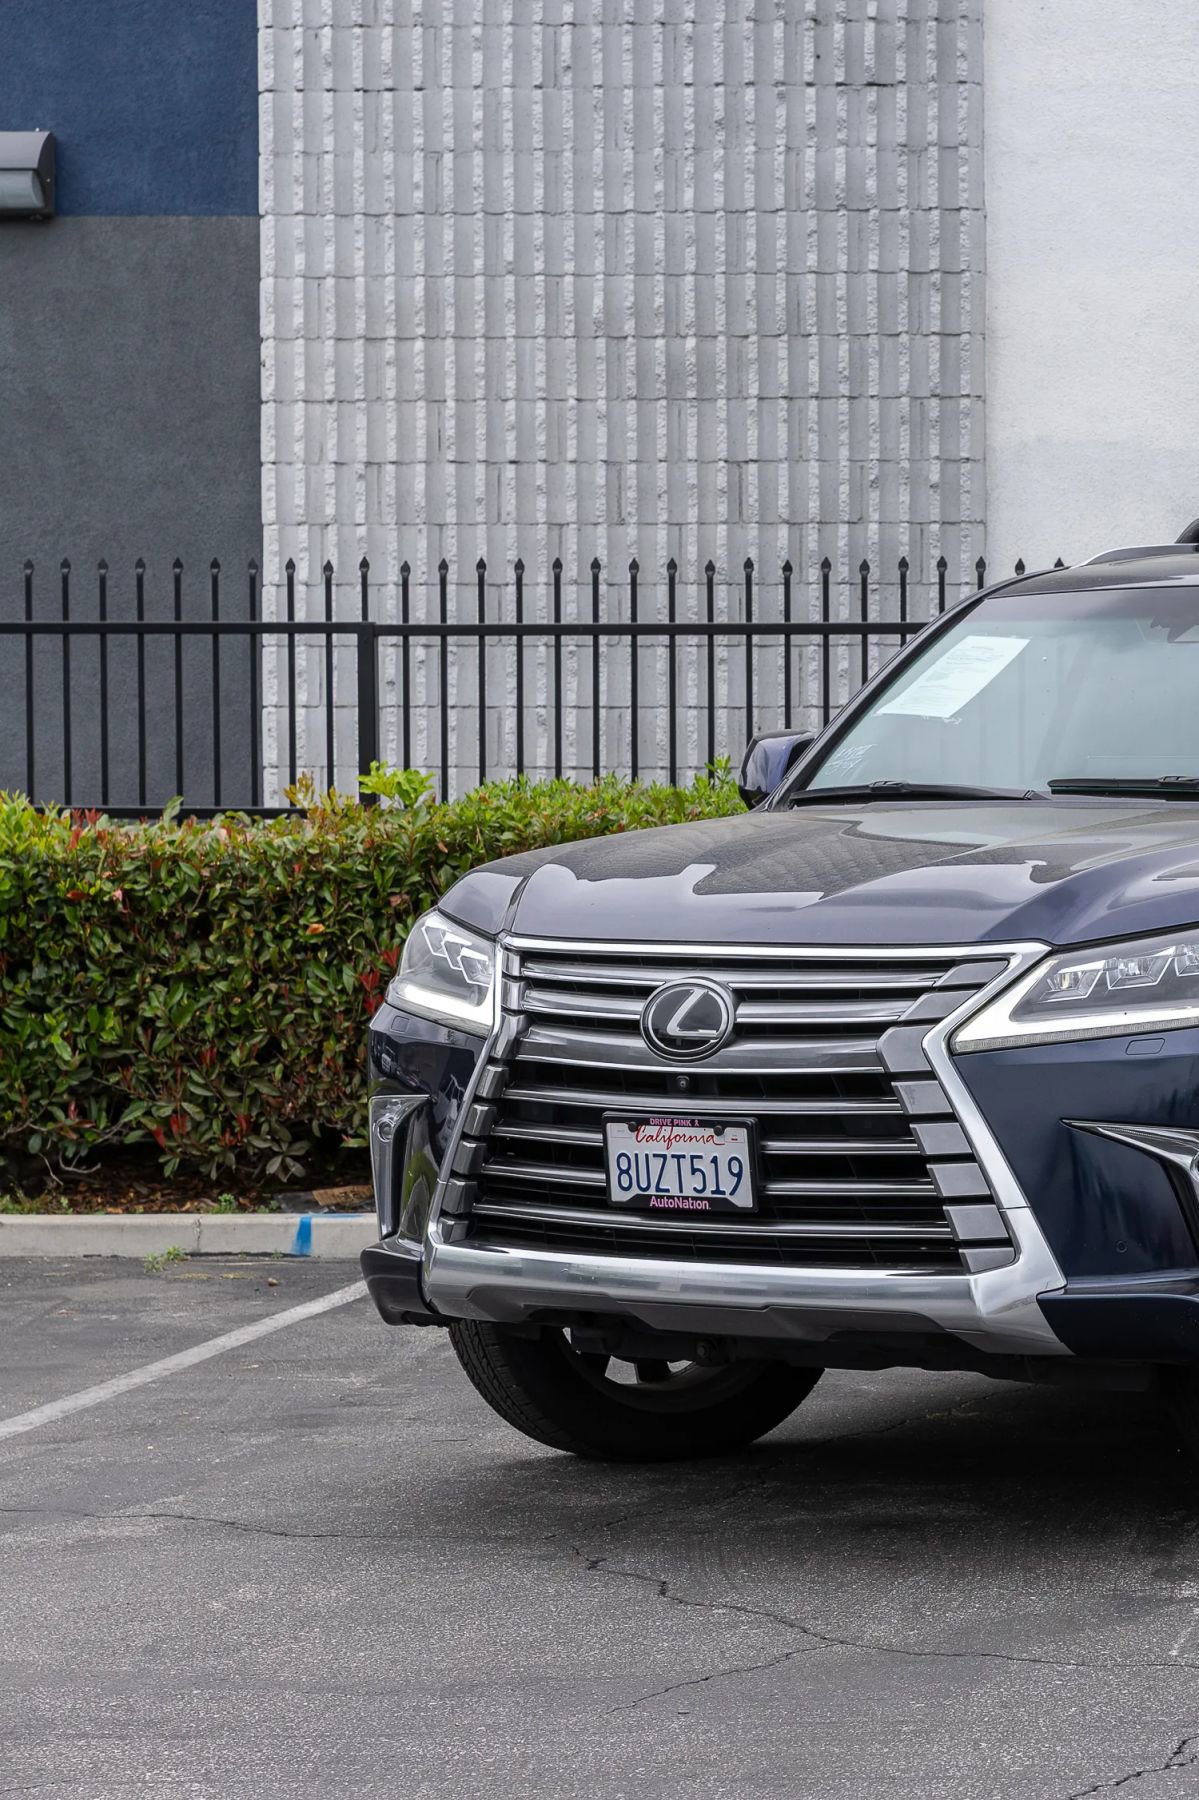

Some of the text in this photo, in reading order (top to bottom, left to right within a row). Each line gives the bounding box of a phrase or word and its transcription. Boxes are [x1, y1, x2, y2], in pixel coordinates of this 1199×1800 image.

[650, 1118, 692, 1127] DRIVE PINK
[634, 1124, 725, 1150] California
[616, 1152, 744, 1196] 8UZT519
[650, 1195, 709, 1210] AutoNation
